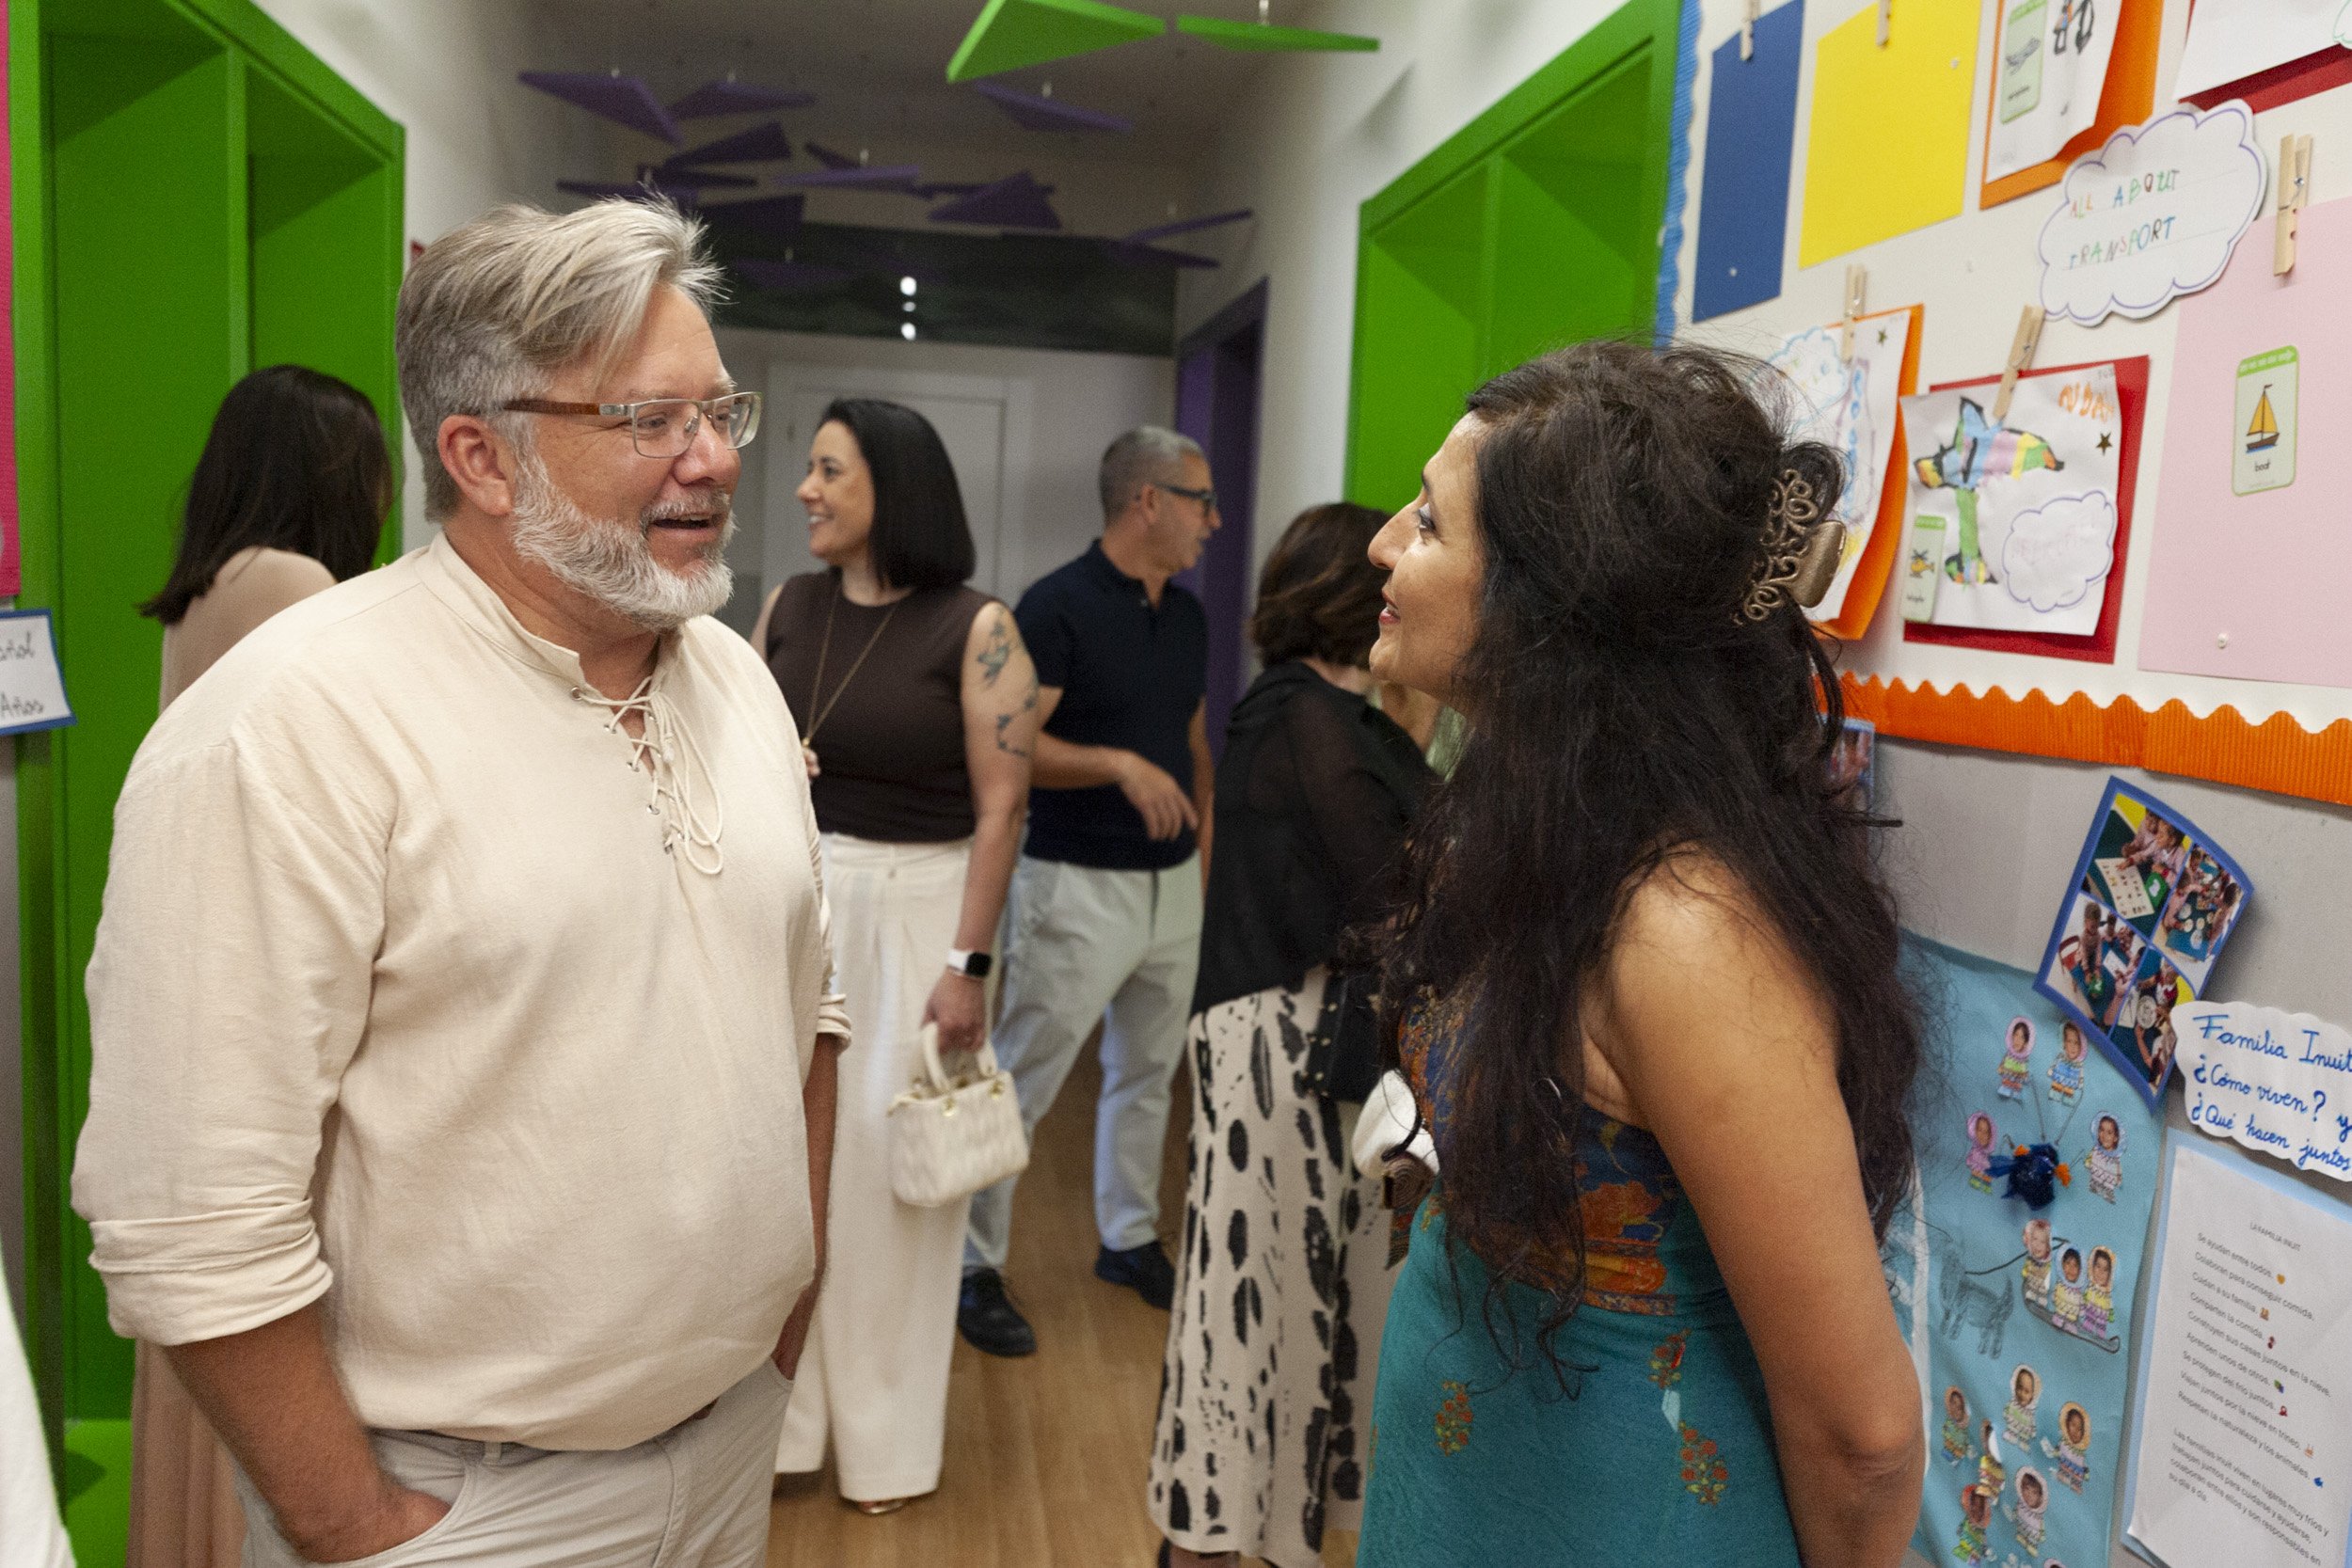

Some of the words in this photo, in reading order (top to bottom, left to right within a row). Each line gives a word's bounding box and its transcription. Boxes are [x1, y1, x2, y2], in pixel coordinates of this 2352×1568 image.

[2112, 168, 2181, 209] ABOUT
[2069, 214, 2176, 270] TRANSPORT
[2254, 458, 2271, 472] boat
[2193, 1014, 2288, 1059] Familia
[2193, 1053, 2251, 1095] ¿Cómo
[2191, 1091, 2235, 1130] ¿Qué
[2245, 1115, 2290, 1149] hacen
[2299, 1138, 2352, 1171] juntos
[2229, 1272, 2245, 1285] para
[2232, 1252, 2249, 1267] entre
